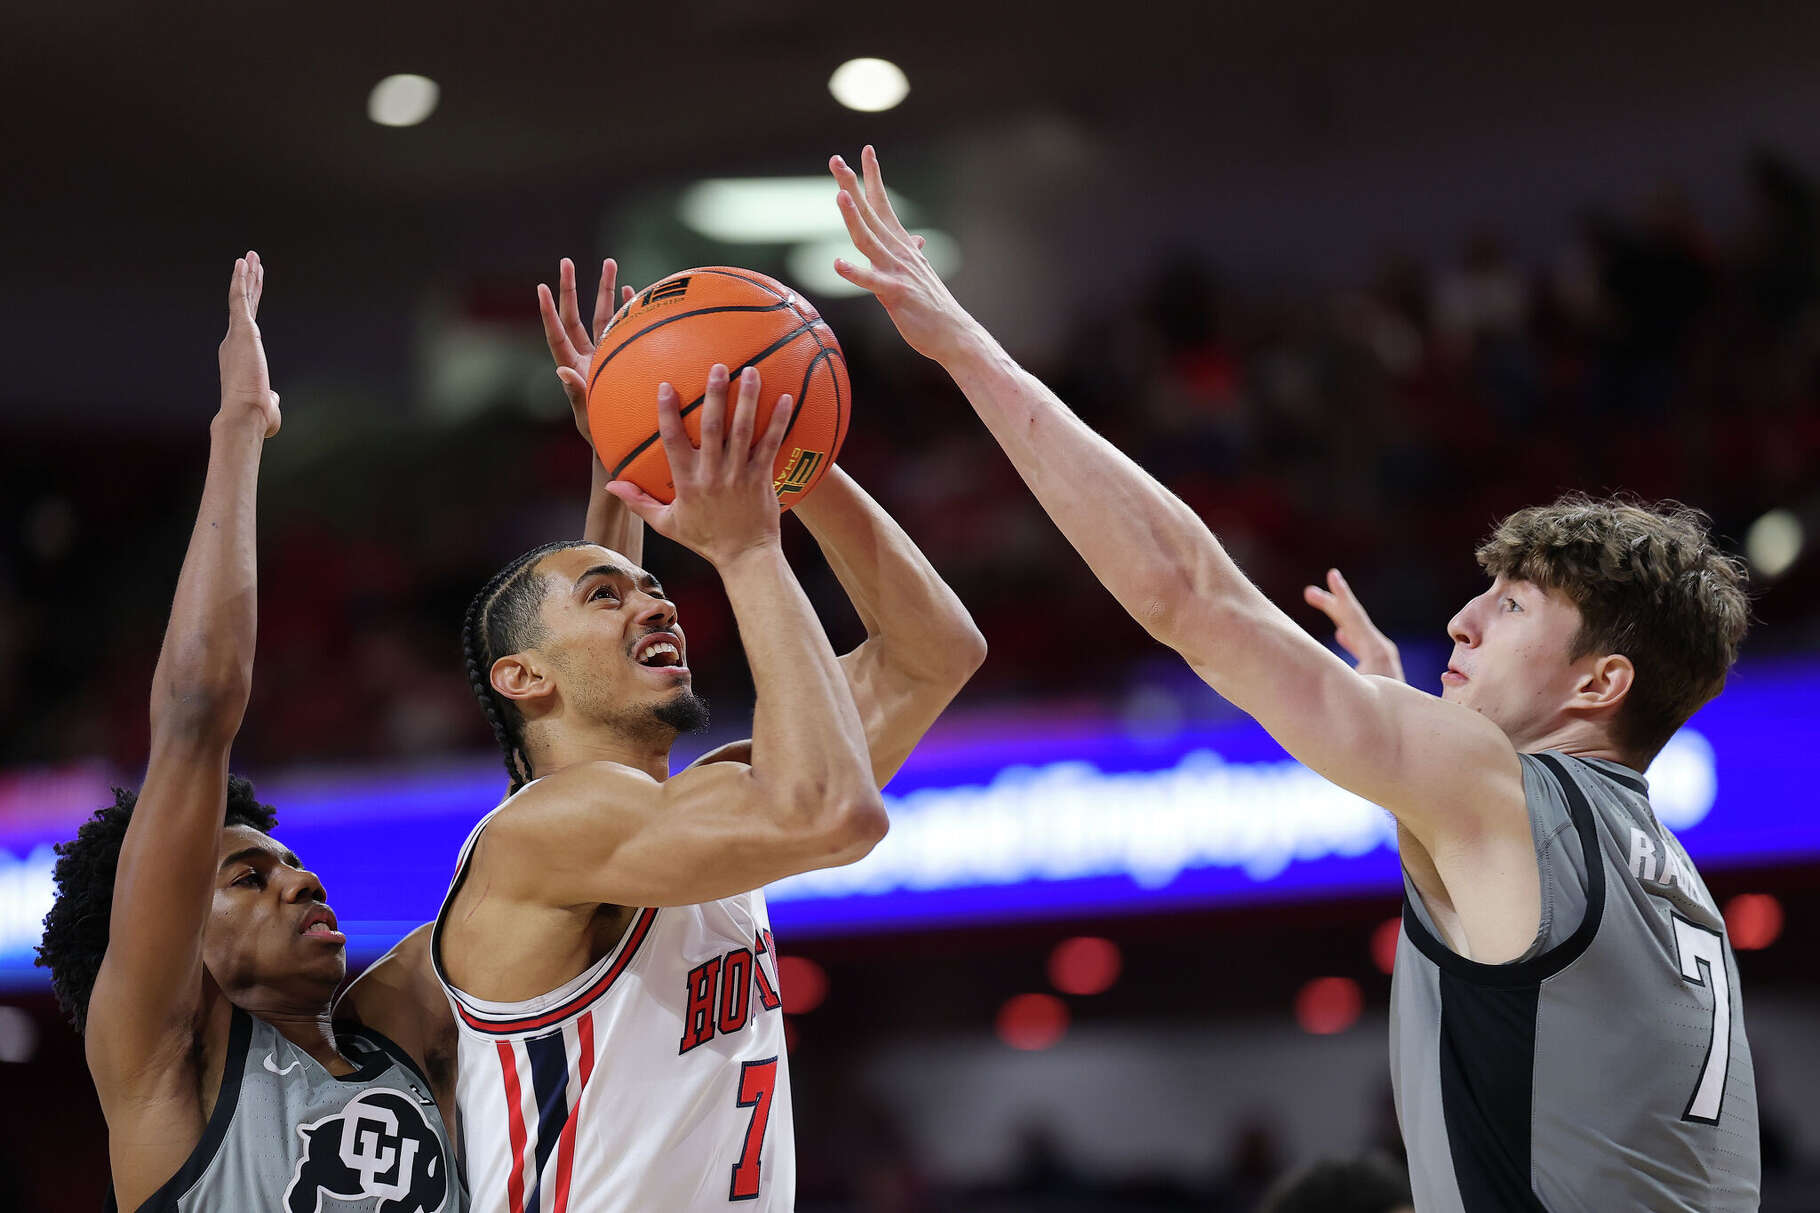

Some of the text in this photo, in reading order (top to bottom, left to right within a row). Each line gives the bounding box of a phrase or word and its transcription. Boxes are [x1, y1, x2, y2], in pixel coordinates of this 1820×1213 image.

[1670, 909, 1730, 1127] 7
[339, 1101, 420, 1201] CU
[729, 1056, 778, 1201] 7
